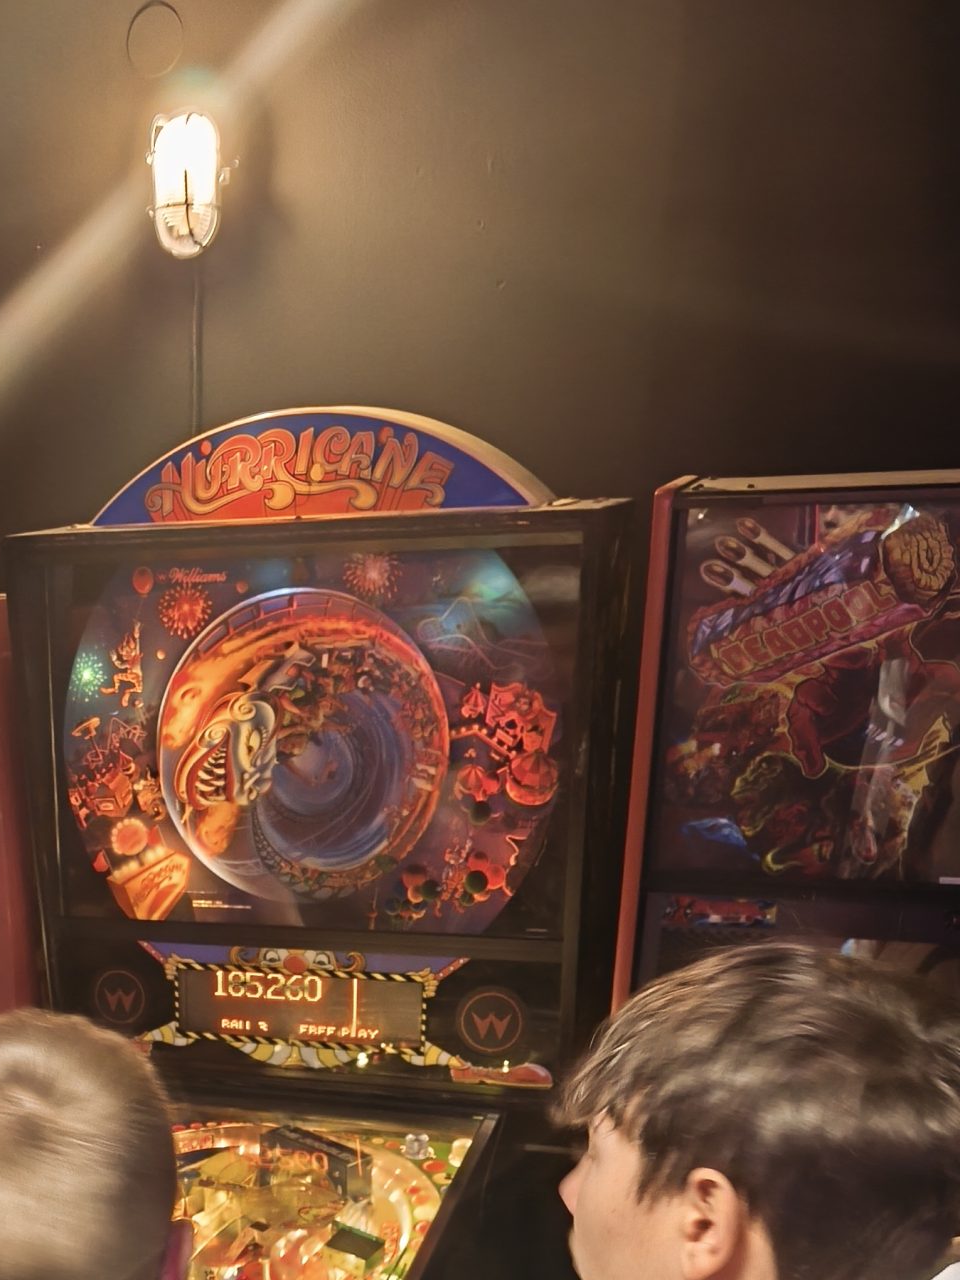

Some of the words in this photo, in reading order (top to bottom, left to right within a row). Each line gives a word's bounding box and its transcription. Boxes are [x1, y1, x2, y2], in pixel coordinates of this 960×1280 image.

[144, 427, 455, 516] HURRICANE
[168, 567, 227, 584] Williams
[716, 580, 897, 675] DEADPOOL
